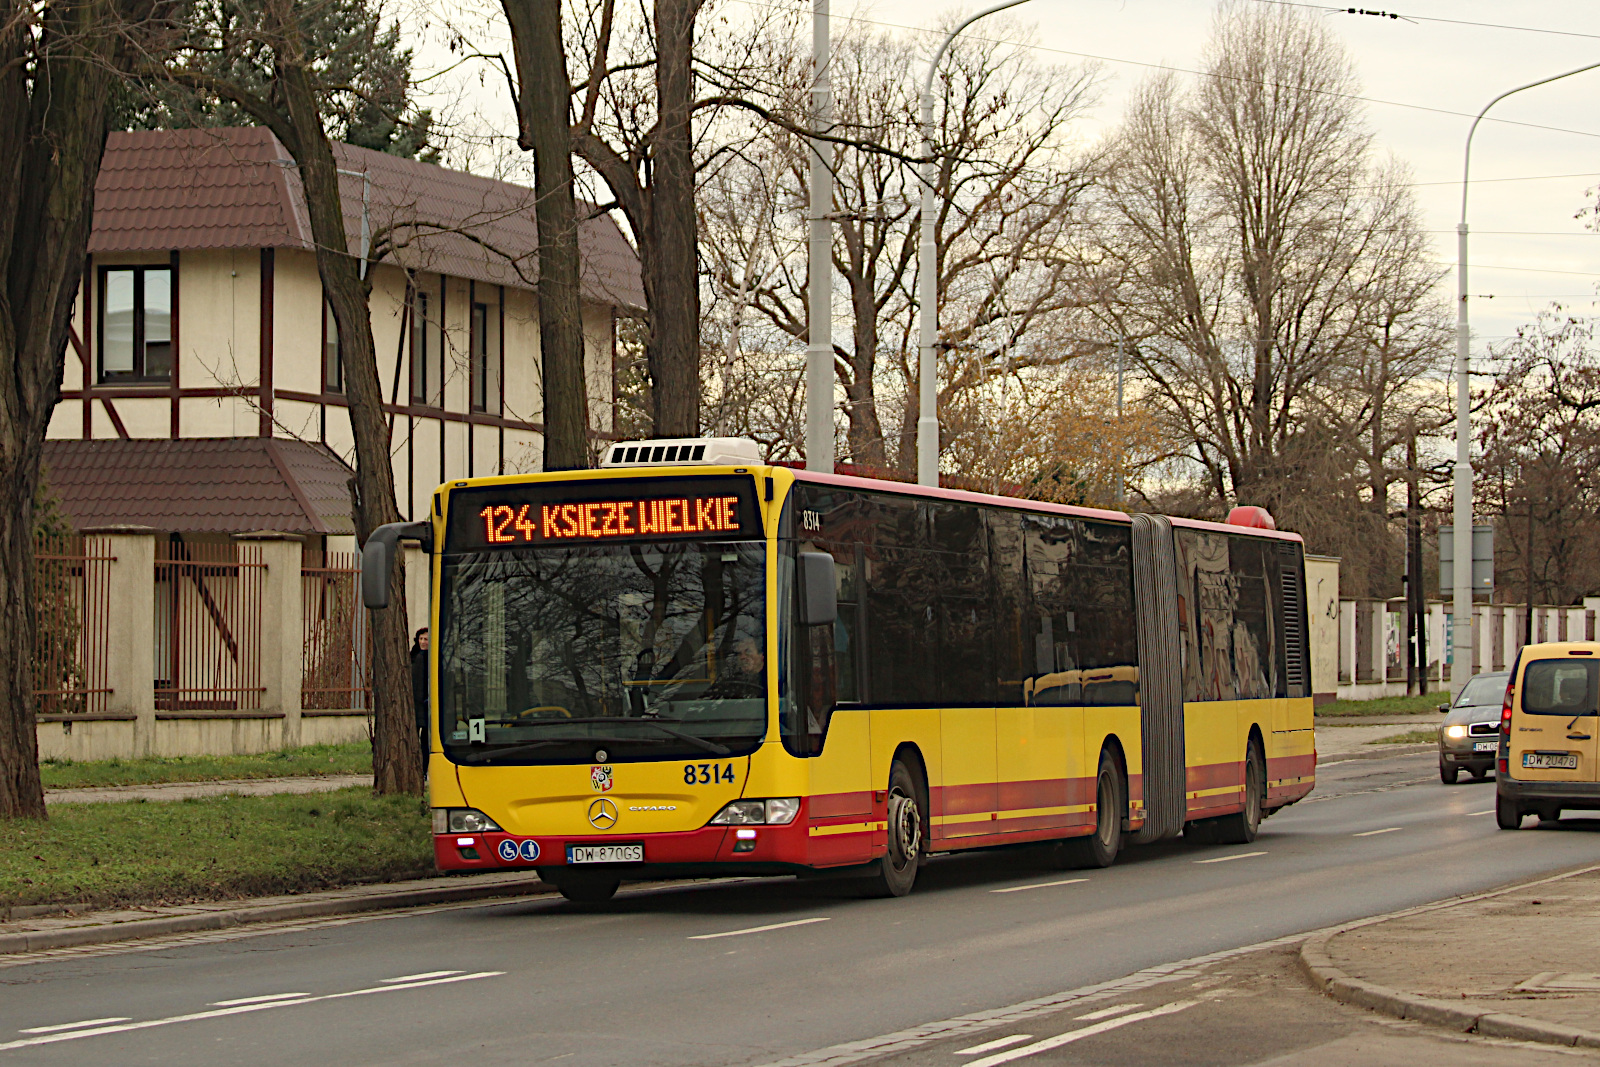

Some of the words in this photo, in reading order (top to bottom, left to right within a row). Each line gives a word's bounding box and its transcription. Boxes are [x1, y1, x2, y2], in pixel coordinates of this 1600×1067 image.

[480, 503, 536, 542] 124
[639, 496, 739, 534] WIELKIE
[803, 509, 820, 531] 8314
[473, 721, 480, 735] 1
[1529, 755, 1543, 765] DW
[1545, 755, 1575, 767] 2U478
[683, 763, 735, 785] 8314
[575, 848, 594, 862] DW
[599, 846, 641, 861] 870GS
